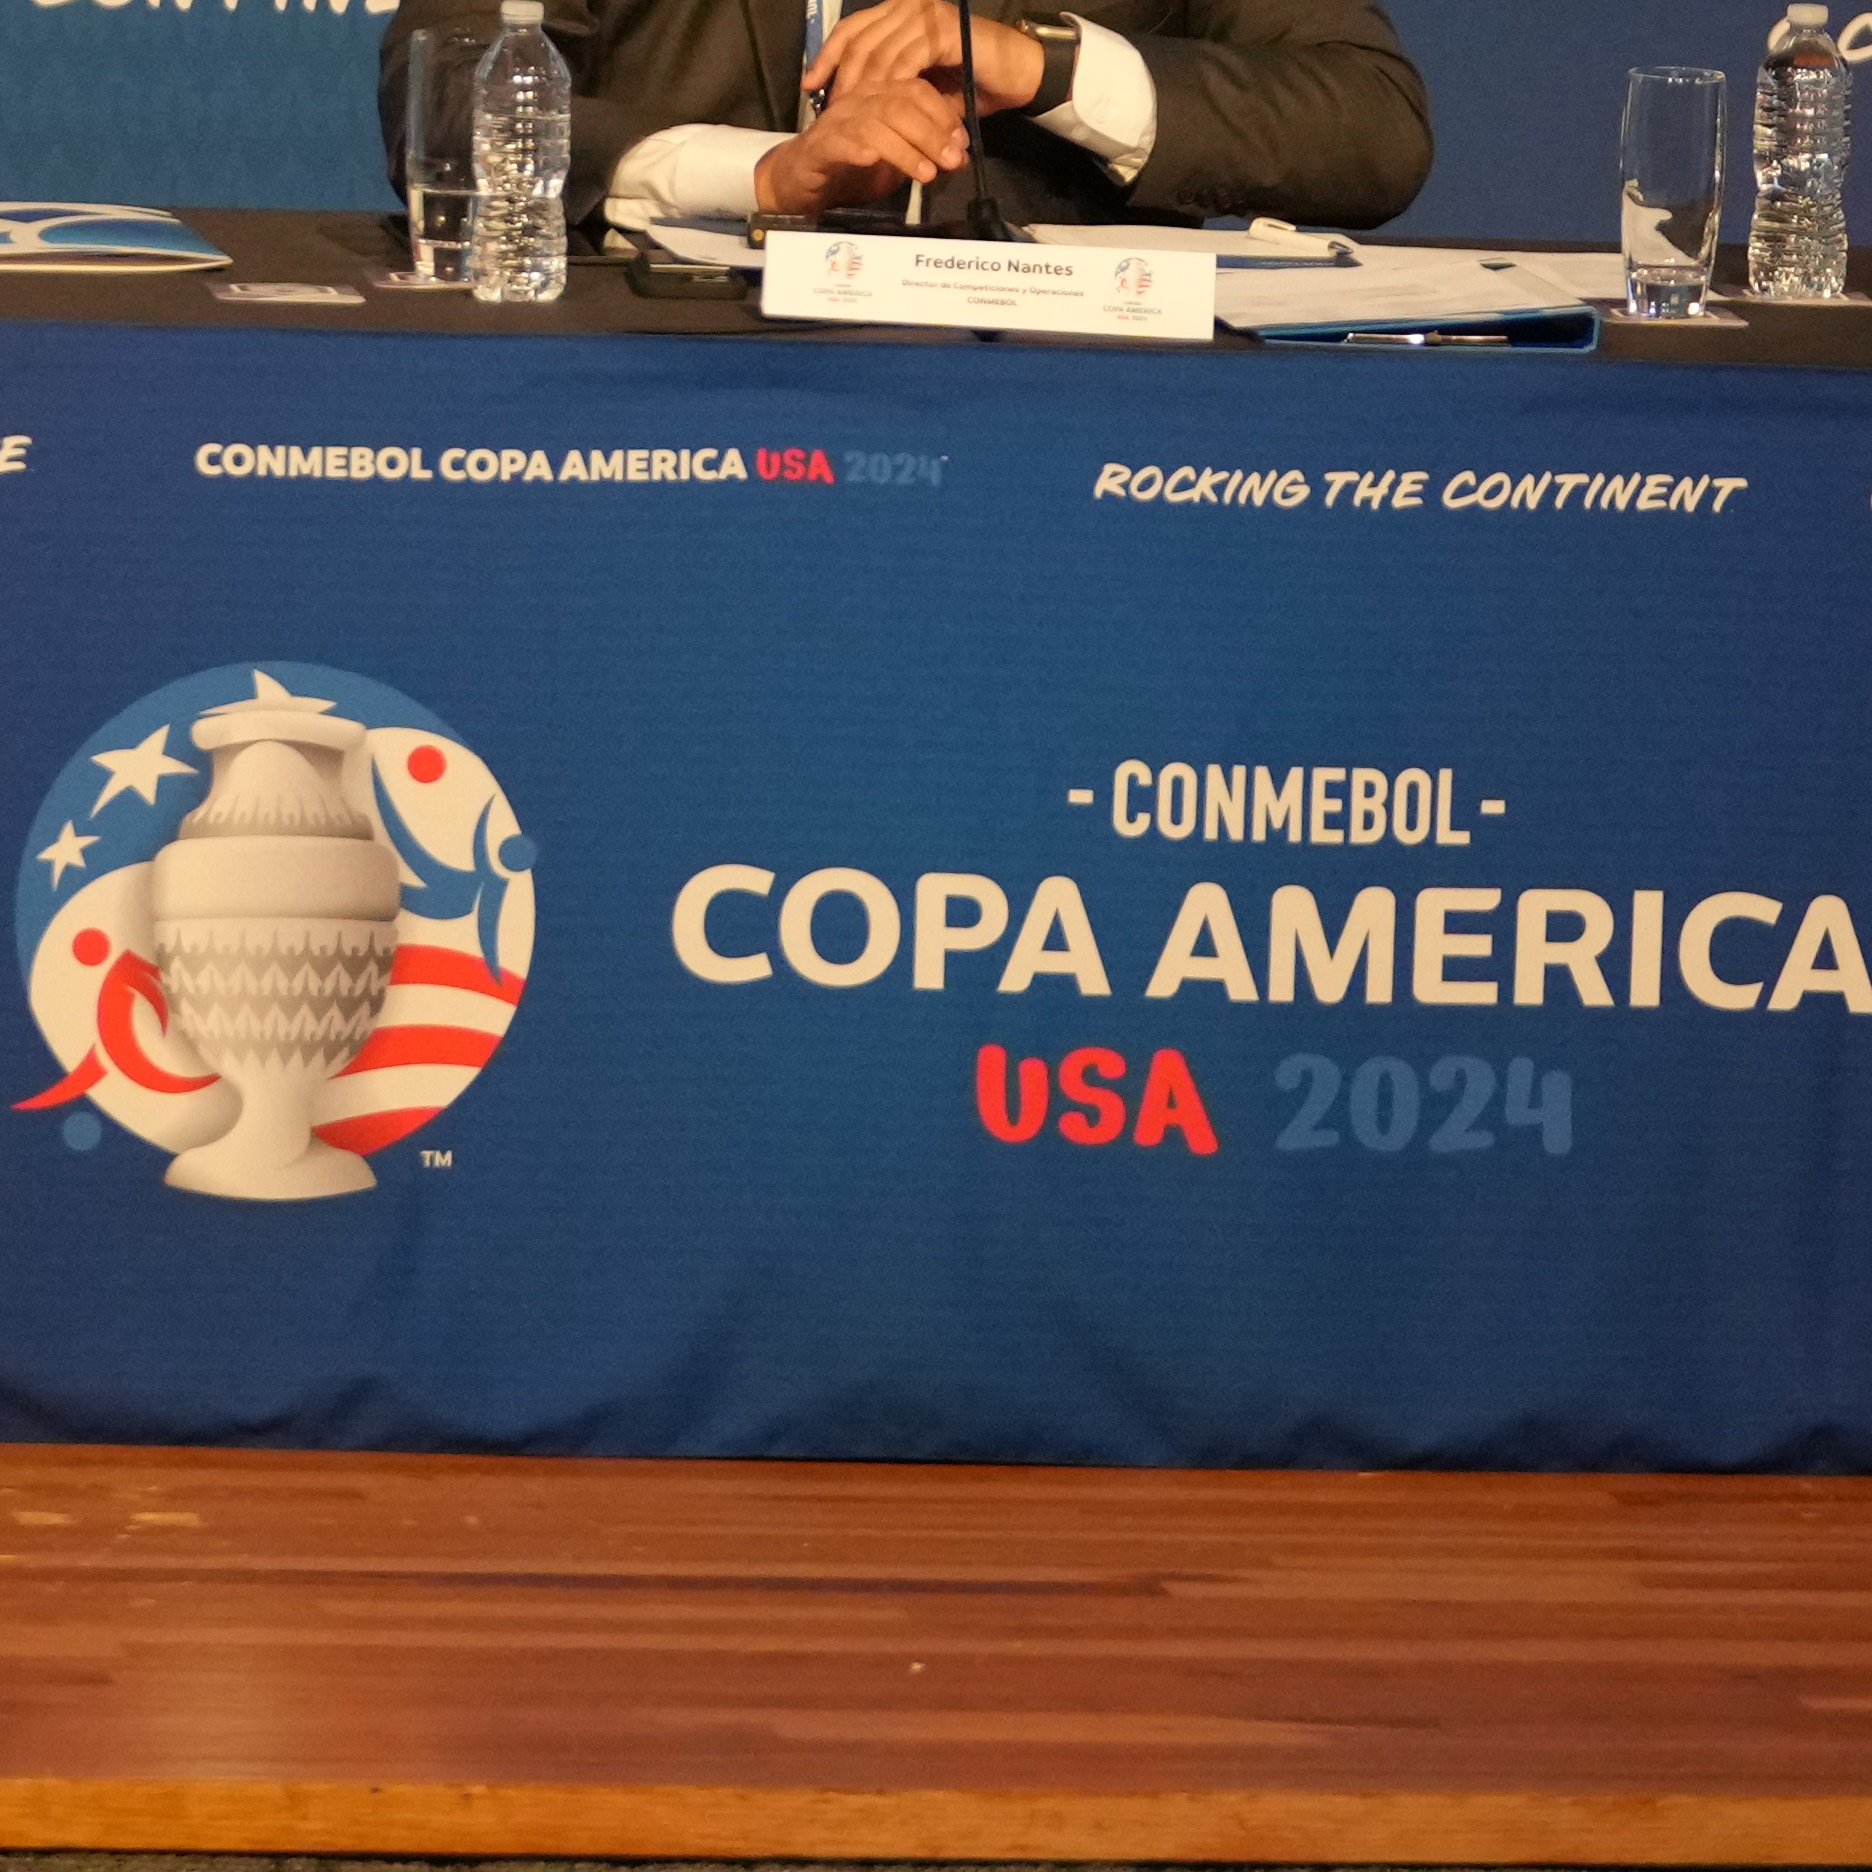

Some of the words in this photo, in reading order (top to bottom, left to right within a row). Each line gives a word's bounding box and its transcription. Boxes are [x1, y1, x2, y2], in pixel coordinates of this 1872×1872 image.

[914, 253, 1002, 274] Frederico
[1007, 259, 1075, 277] Nantes
[195, 442, 434, 480] CONMEBOL
[438, 446, 554, 483] COPA
[558, 447, 748, 482] AMERICA
[755, 447, 835, 484] USA
[844, 451, 943, 486] 2024
[1093, 462, 1311, 509] ROCKING
[1323, 469, 1429, 510] THE
[1441, 470, 1748, 513] CONTINENT
[671, 863, 1112, 996] COPA
[976, 1044, 1220, 1156] USA
[1275, 1053, 1574, 1156] 2024
